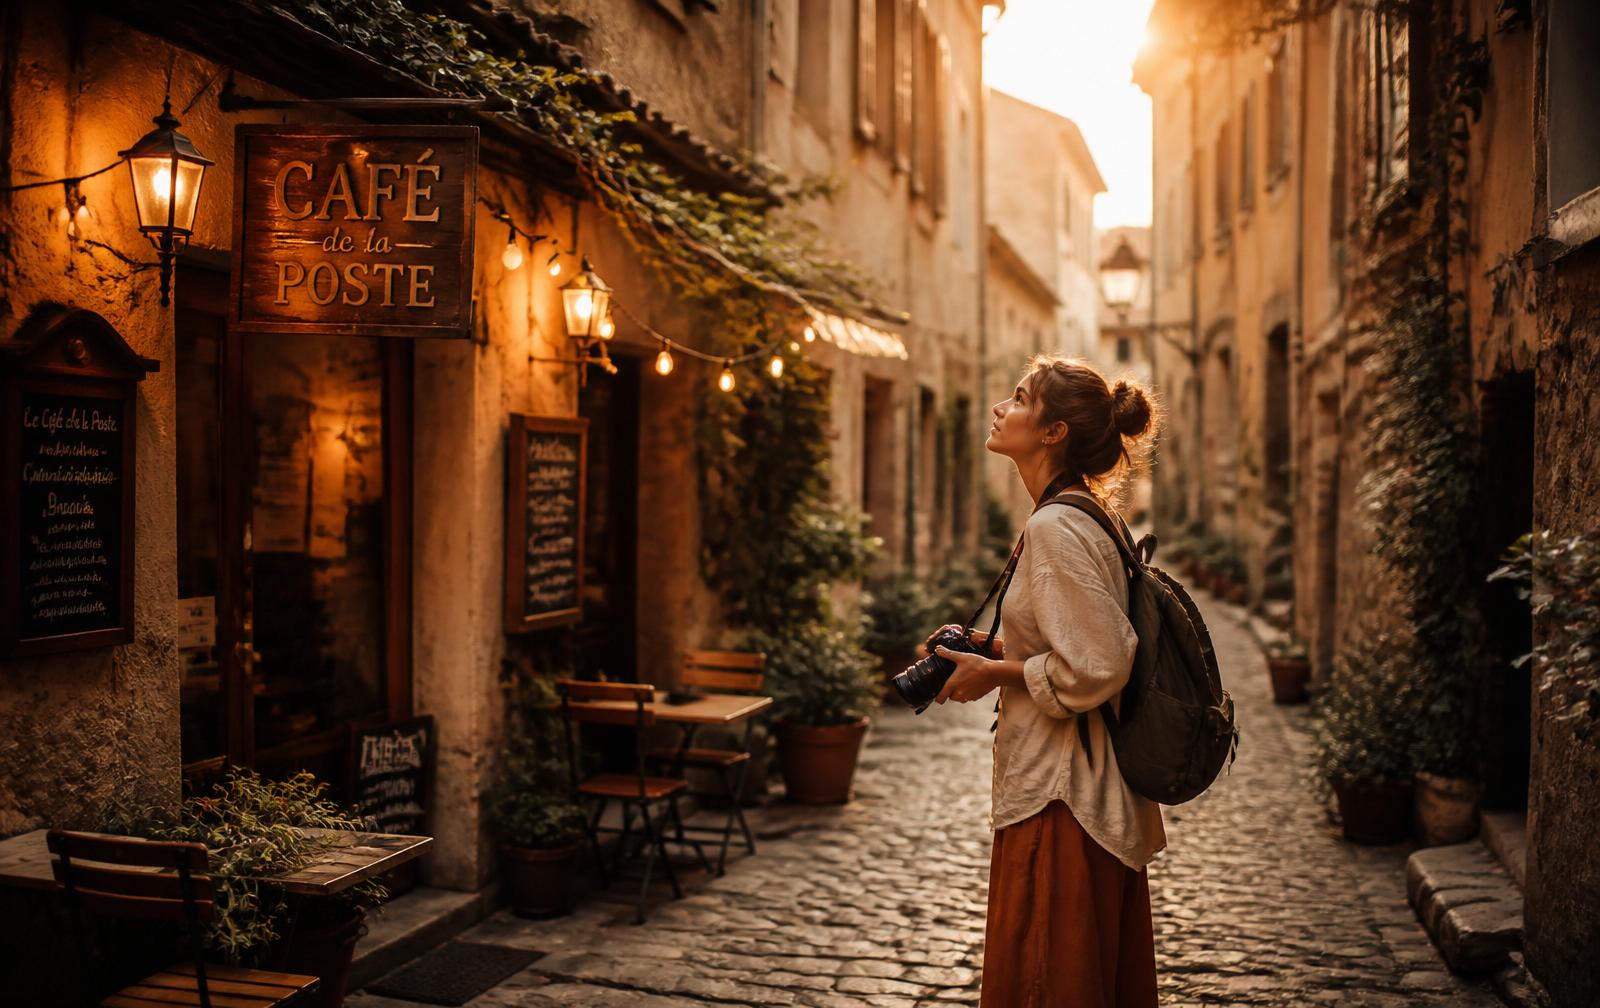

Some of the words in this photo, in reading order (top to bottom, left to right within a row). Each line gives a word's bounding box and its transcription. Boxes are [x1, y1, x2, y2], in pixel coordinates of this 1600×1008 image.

[274, 148, 440, 222] CAFÉ
[323, 226, 353, 252] de
[363, 227, 393, 253] la
[274, 261, 435, 308] POSTE
